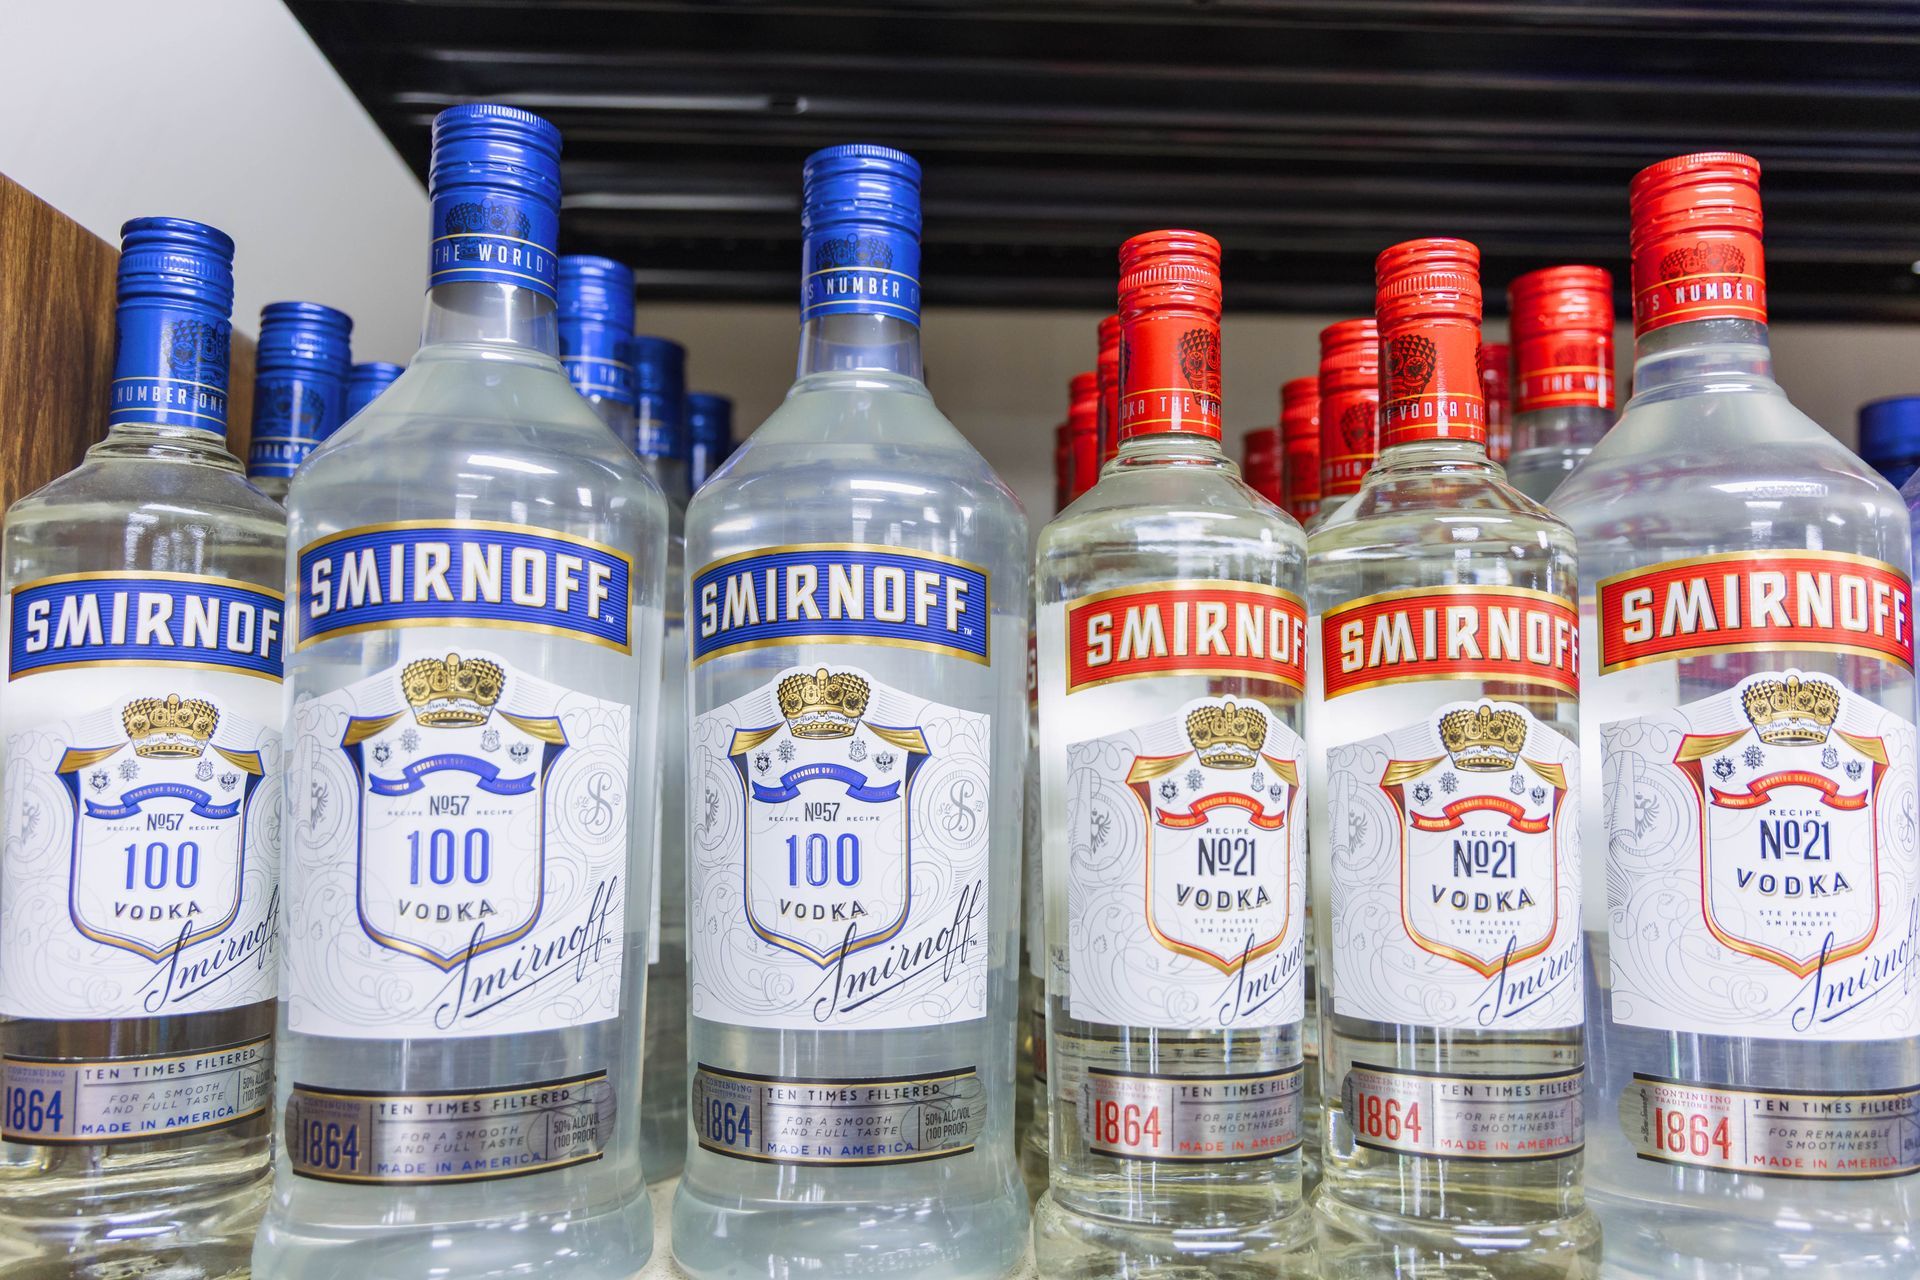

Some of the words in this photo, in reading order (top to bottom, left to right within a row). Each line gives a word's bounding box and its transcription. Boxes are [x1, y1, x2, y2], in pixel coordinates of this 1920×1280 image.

[436, 244, 460, 264] THE
[827, 277, 900, 298] NUMBER
[1676, 282, 1754, 304] NUMBER
[117, 386, 187, 405] NUMBER
[200, 393, 222, 414] ONE
[1160, 396, 1190, 412] THE
[1400, 402, 1458, 420] VODKA
[310, 542, 612, 620] SMIRNOFF
[701, 564, 969, 638] SMIRNOFF
[1622, 571, 1906, 644] SMIRNOFF
[26, 591, 284, 662] SMIRNOF
[1206, 827, 1250, 835] RECIPE
[1462, 830, 1508, 838] RECIPE
[124, 841, 199, 890] 100
[407, 828, 490, 884] 100
[786, 832, 860, 887] 100
[1736, 868, 1852, 898] VODKA
[1176, 882, 1272, 912] VODKA
[1432, 884, 1536, 914] VODKA
[114, 900, 202, 922] VODKA
[398, 899, 497, 923] VODKA
[780, 898, 869, 922] VODKA
[84, 1068, 120, 1080] TEN
[134, 1064, 186, 1078] TIMES
[196, 1048, 256, 1070] FILTERED
[109, 1093, 140, 1105] FOR
[148, 1092, 157, 1101] A
[164, 1082, 220, 1099] SMOOTH
[768, 1087, 798, 1100] TEN
[808, 1090, 858, 1102] TIMES
[868, 1084, 940, 1100] FILTERED
[1180, 1086, 1212, 1098] TEN
[1224, 1083, 1266, 1096] TIMES
[1441, 1084, 1474, 1096] TEN
[1486, 1084, 1532, 1097] TIMES
[1654, 1088, 1732, 1105] CONTINUING
[6, 1086, 64, 1132] 1864
[102, 1104, 134, 1116] AND
[142, 1101, 178, 1112] FULL
[186, 1092, 226, 1108] TASTE
[379, 1102, 414, 1116] TEN
[426, 1100, 482, 1115] TIMES
[493, 1090, 570, 1111] FILTERED
[1194, 1113, 1219, 1122] FOR
[1226, 1104, 1292, 1122] REMARKABLE
[1754, 1100, 1790, 1112] TEN
[1802, 1102, 1852, 1114] TIMES
[1861, 1098, 1912, 1114] FILTERED
[82, 1122, 132, 1134] MADE
[140, 1120, 156, 1130] IN
[164, 1106, 236, 1128] AMERICA
[706, 1096, 753, 1148] 1864
[786, 1116, 813, 1126] FOR
[819, 1117, 828, 1126] A
[836, 1115, 893, 1126] SMOOTH
[925, 1112, 942, 1126] 50%
[1095, 1098, 1162, 1148] 1864
[1358, 1092, 1422, 1144] 1864
[1456, 1112, 1482, 1122] FOR
[1490, 1108, 1567, 1122] REMARKABLE
[400, 1132, 434, 1142] FOR
[438, 1131, 448, 1140] A
[455, 1126, 519, 1140] SMOOTH
[780, 1126, 810, 1137] AND
[815, 1128, 848, 1138] FULL
[856, 1126, 900, 1136] TASTE
[926, 1126, 942, 1143] (100
[944, 1122, 968, 1138] PROOF)
[1209, 1118, 1284, 1134] SMOOTHNESS
[1472, 1121, 1556, 1134] SMOOTHNESS
[1656, 1107, 1732, 1160] 1864
[1769, 1128, 1800, 1138] FOR
[1806, 1128, 1890, 1138] REMARKABLE
[303, 1118, 360, 1170] 1864
[394, 1144, 425, 1154] AND
[434, 1142, 470, 1153] FULL
[478, 1136, 525, 1149] TASTE
[767, 1142, 810, 1156] MADE
[818, 1146, 832, 1156] IN
[840, 1142, 915, 1156] AMERICA
[1179, 1141, 1224, 1152] MADE
[1232, 1142, 1245, 1150] IN
[1440, 1140, 1487, 1150] MADE
[1496, 1140, 1510, 1150] IN
[1518, 1136, 1570, 1150] AMERICA
[1786, 1140, 1880, 1150] SMOOTHNESS
[378, 1162, 427, 1174] MADE
[436, 1160, 452, 1172] IN
[462, 1152, 541, 1171] AMERICA
[1753, 1155, 1804, 1168] MADE
[1813, 1158, 1828, 1169] IN
[1836, 1156, 1898, 1169] AMERICA
